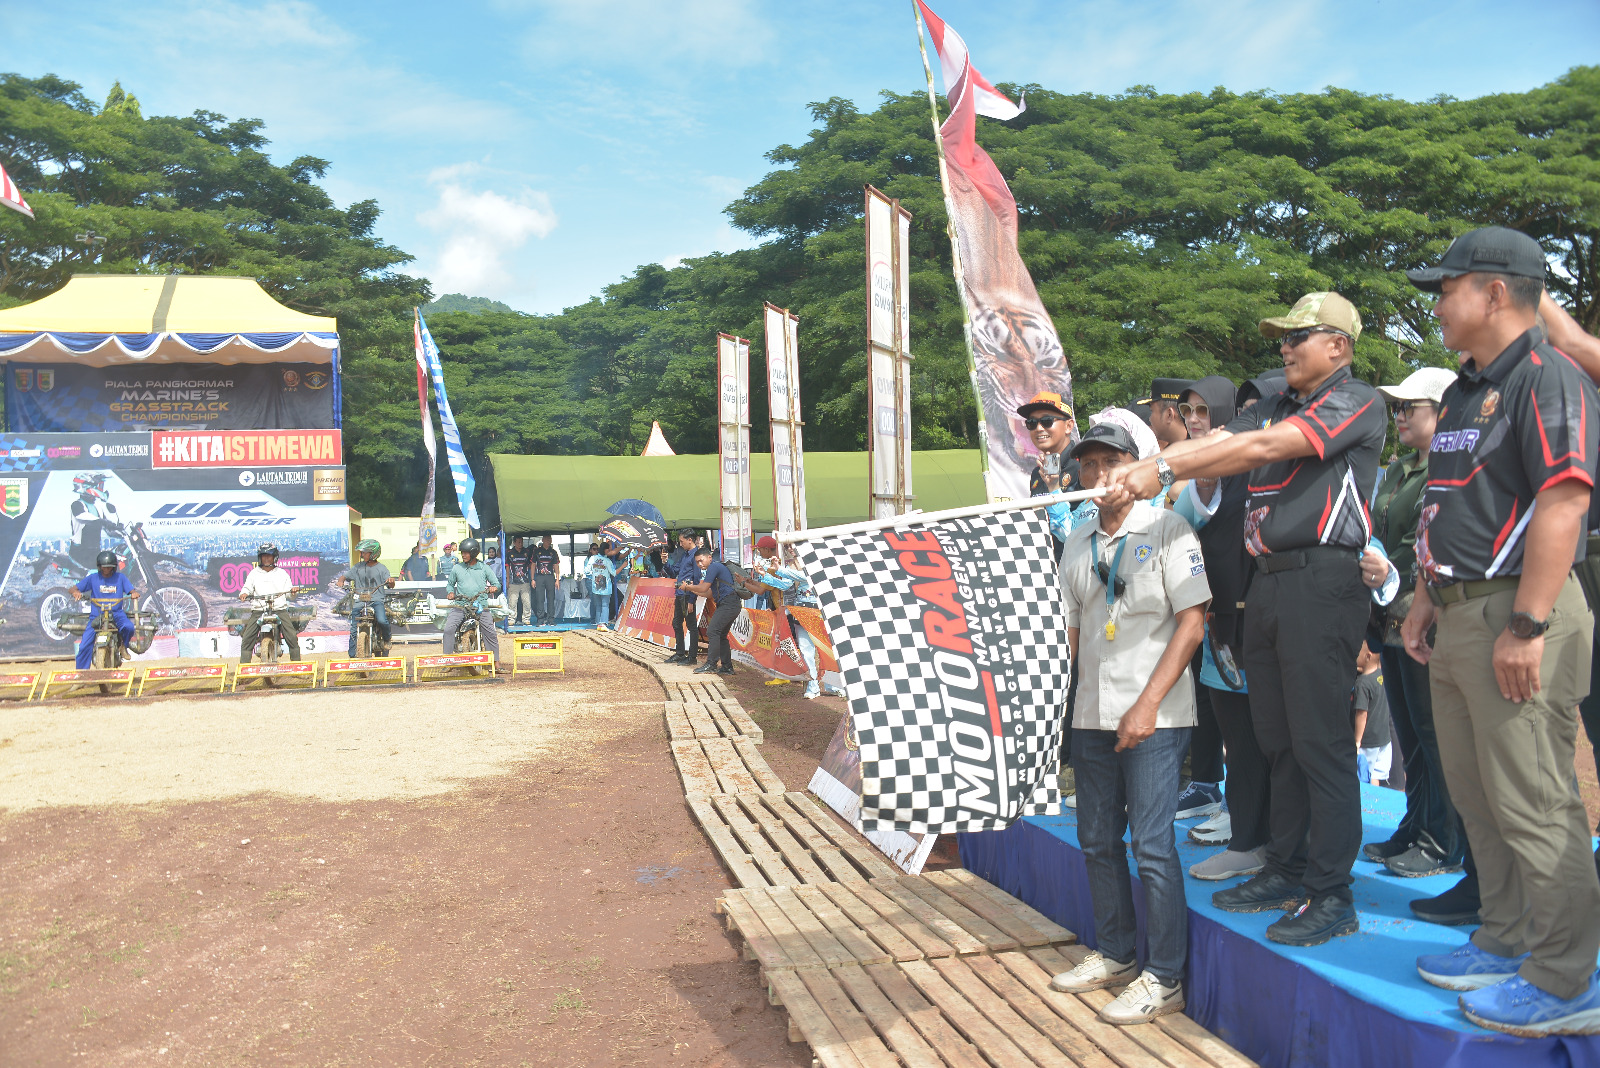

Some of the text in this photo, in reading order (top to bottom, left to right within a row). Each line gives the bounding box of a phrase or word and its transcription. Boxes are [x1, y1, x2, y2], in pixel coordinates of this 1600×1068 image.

[105, 380, 234, 388] PIALA PANGKORMAR
[120, 390, 220, 400] MARINE'S
[109, 402, 230, 412] GRASSTRACK
[121, 412, 219, 421] CHAMPIONSHIP
[932, 529, 991, 667] MANAGEMENT
[969, 539, 1013, 665] MANAGEMENT
[211, 637, 219, 652] 1
[305, 637, 316, 651] 3
